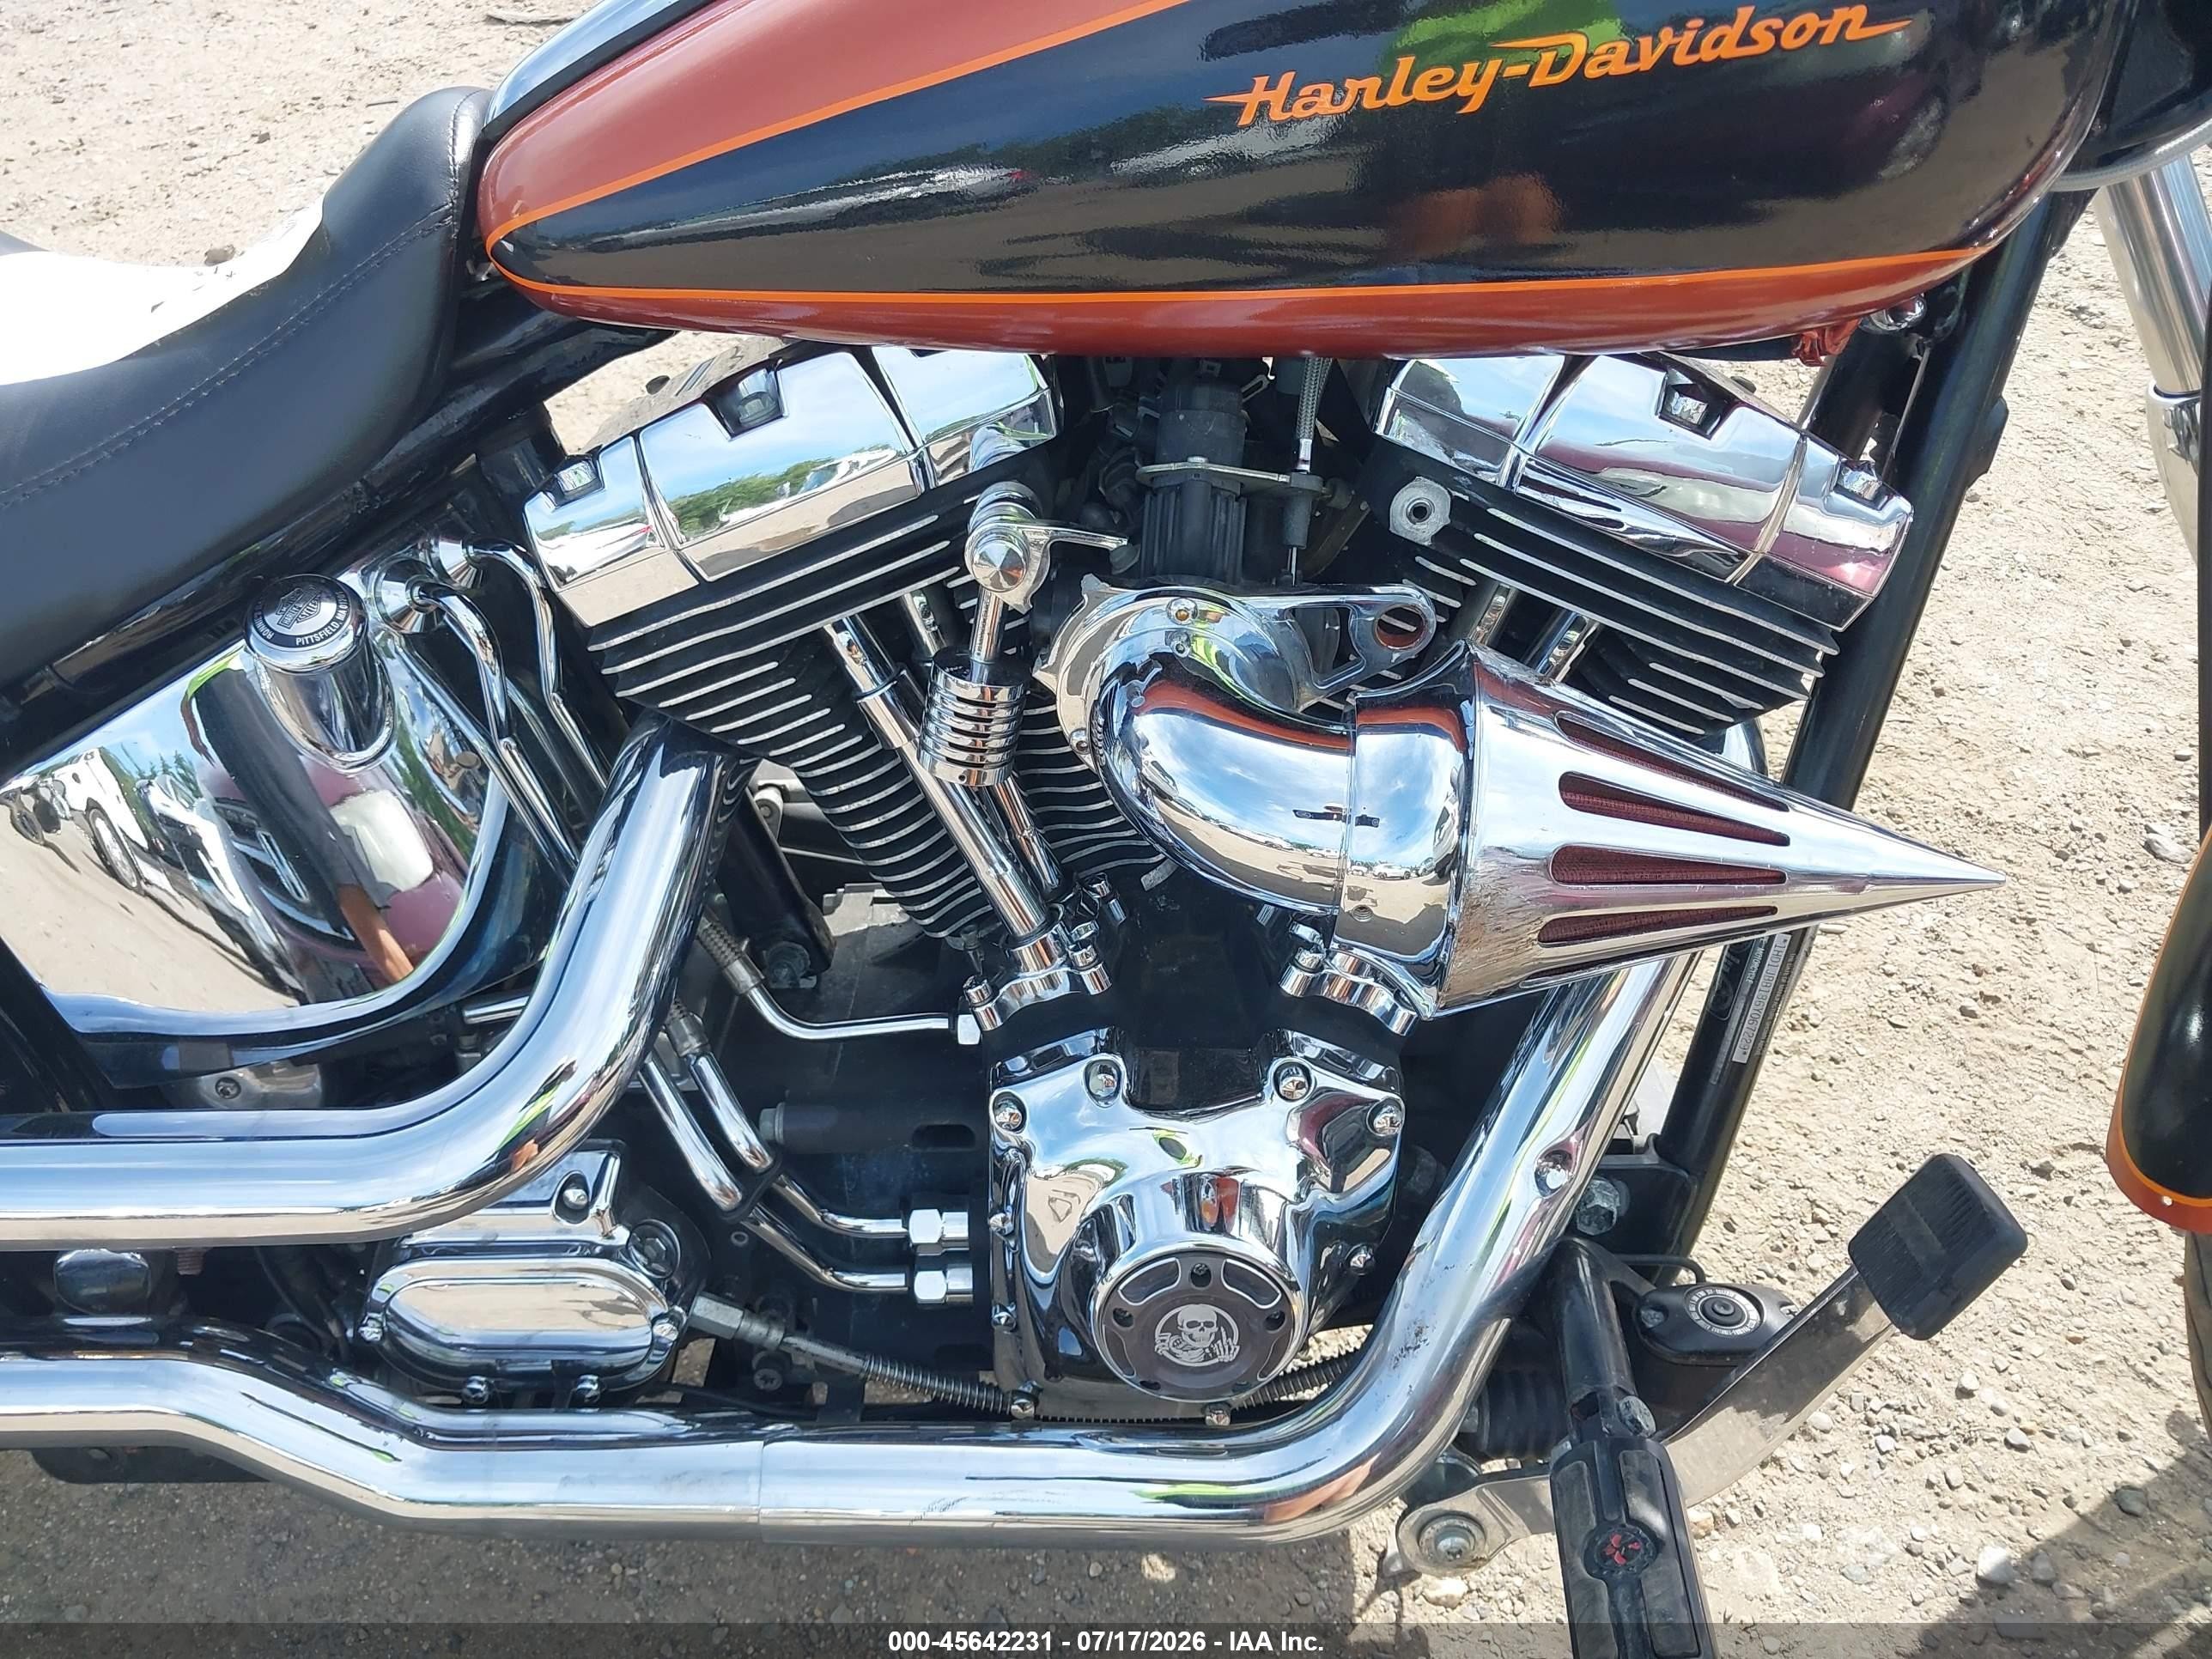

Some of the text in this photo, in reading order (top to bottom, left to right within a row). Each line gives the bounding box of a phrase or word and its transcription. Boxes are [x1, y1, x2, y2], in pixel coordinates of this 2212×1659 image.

[1204, 3, 1913, 126] Harley-Davidson
[295, 621, 343, 646] PITTSFIELD,
[335, 610, 348, 622] MA
